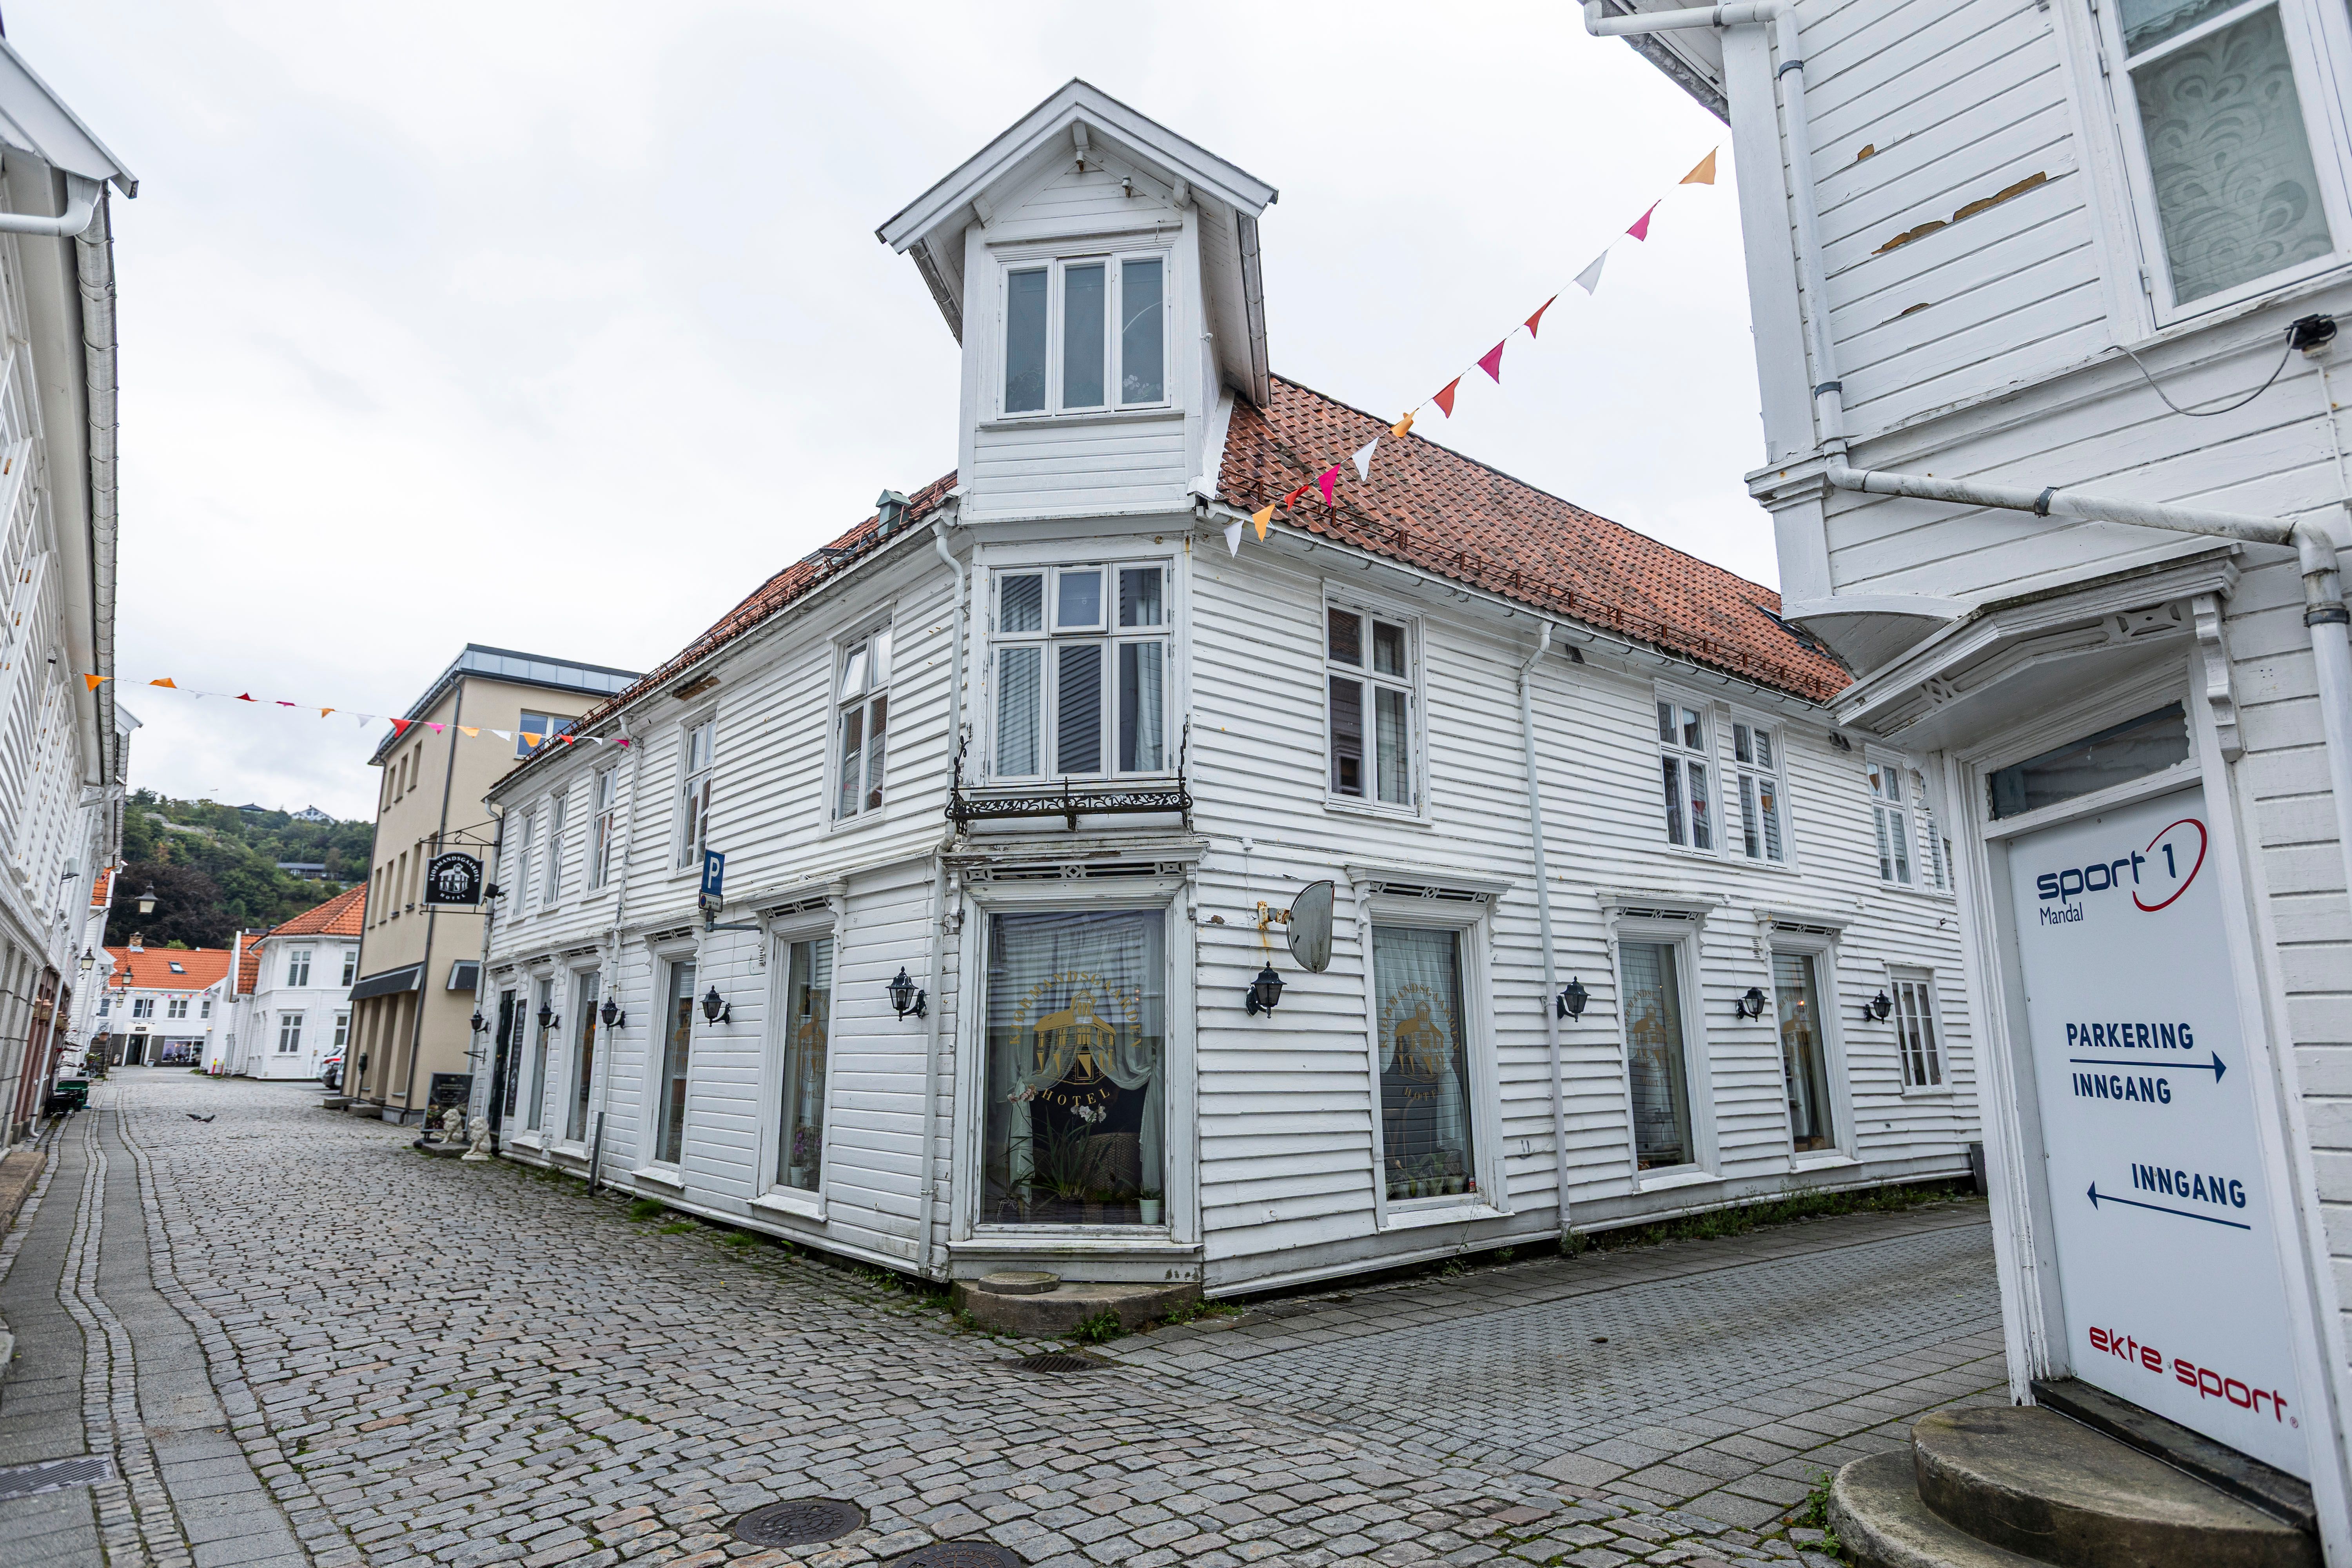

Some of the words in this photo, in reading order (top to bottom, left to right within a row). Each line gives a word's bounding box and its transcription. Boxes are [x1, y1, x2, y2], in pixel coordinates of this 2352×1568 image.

[708, 857, 720, 889] P
[2036, 850, 2146, 905] sport
[2162, 843, 2177, 878] 1
[2040, 902, 2084, 926] Mandal
[1009, 970, 1142, 1048] KJØBMANDSGAARDEN
[1379, 983, 1459, 1050] KJØBMANDSGAARDEN
[2066, 1023, 2194, 1050] PARKERING
[1041, 1087, 1111, 1106] HOTEL
[1403, 1085, 1445, 1101] HOTEL
[2073, 1073, 2172, 1105] INNGANG
[2131, 1163, 2247, 1209] INNGANG
[2089, 1326, 2163, 1374] ekte
[2173, 1358, 2288, 1423] sport
